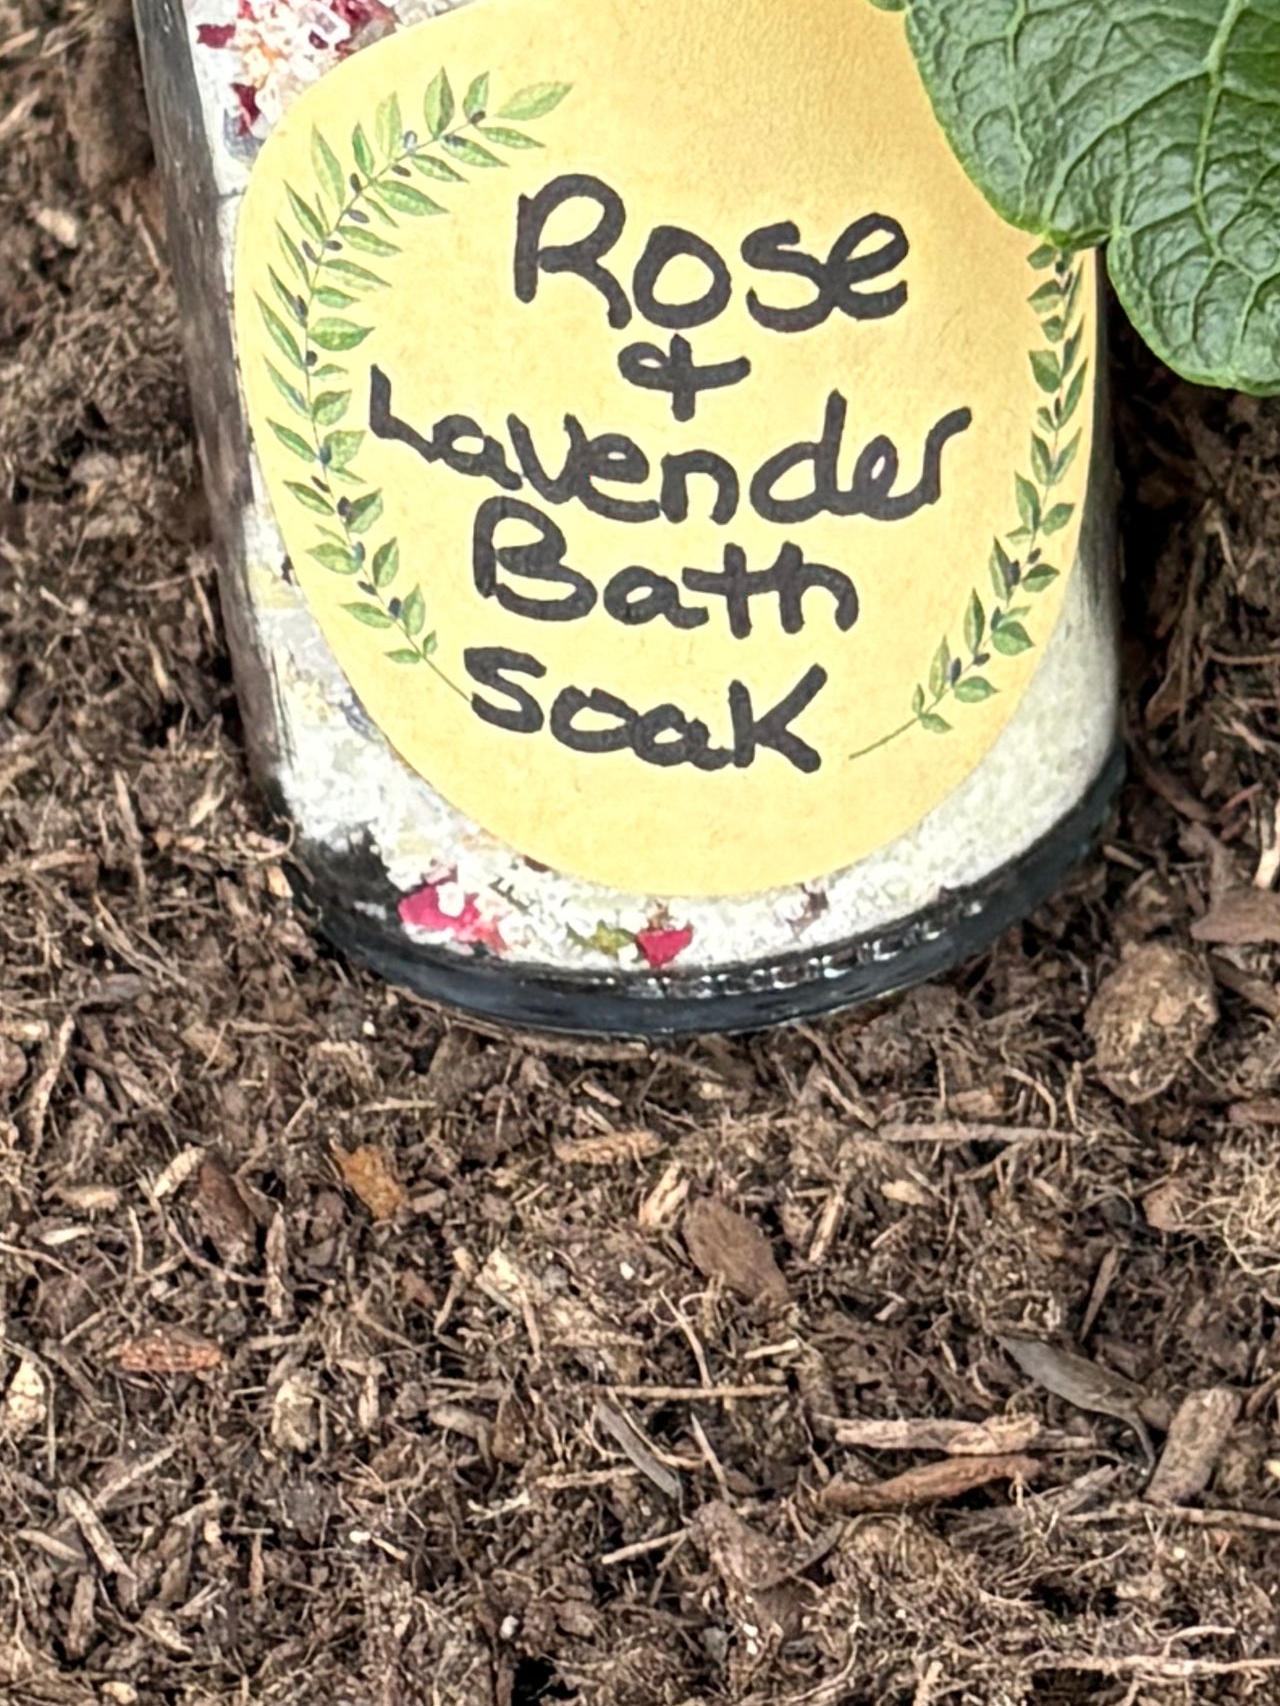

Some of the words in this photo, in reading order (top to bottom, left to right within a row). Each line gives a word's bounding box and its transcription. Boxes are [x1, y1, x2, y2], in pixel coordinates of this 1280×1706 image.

[513, 173, 910, 334] Rose
[369, 364, 972, 524] Lavender
[472, 495, 860, 640] Bath
